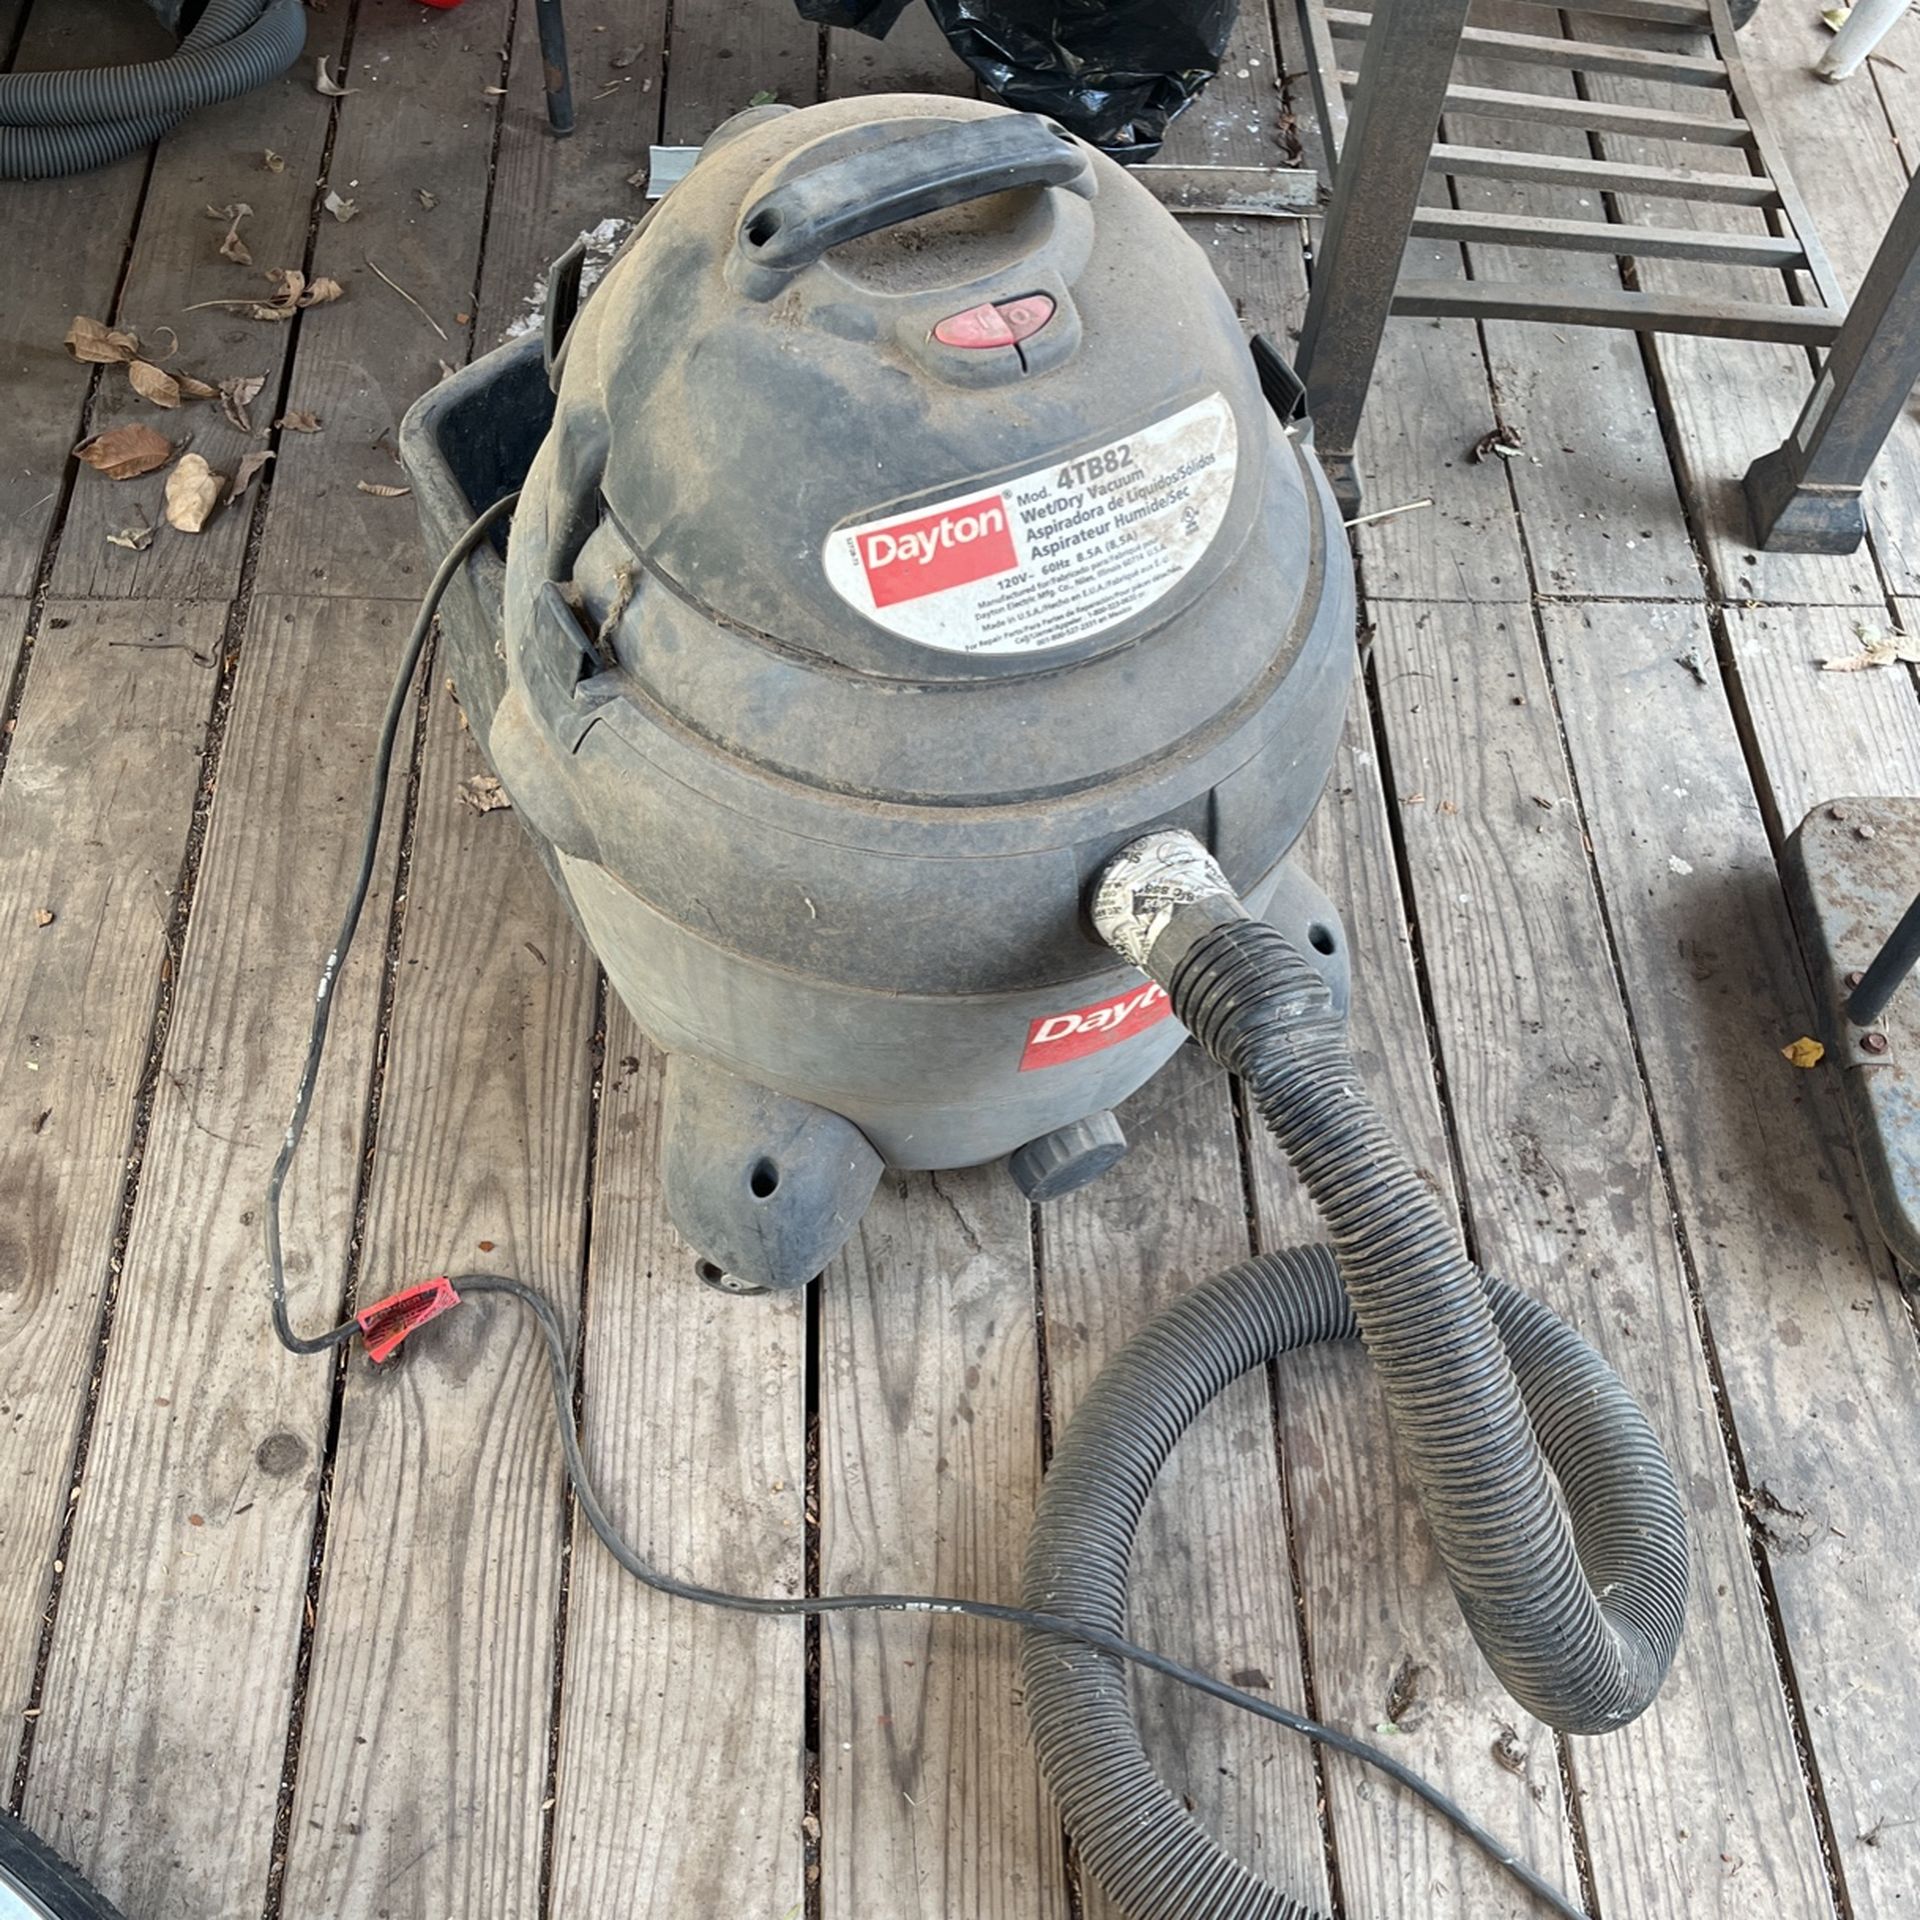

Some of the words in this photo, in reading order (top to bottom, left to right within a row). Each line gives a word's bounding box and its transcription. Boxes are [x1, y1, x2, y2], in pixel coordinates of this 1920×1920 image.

[1017, 486, 1052, 507] Mod.
[1057, 444, 1133, 489] 4TB82
[1020, 493, 1084, 524] Wet/Dry
[1087, 469, 1145, 499] Vacuum
[867, 508, 1003, 569] Dayton
[1026, 505, 1104, 543] Aspiradora
[1108, 496, 1124, 511] de
[1031, 522, 1111, 560] Aspirateur
[1113, 486, 1190, 528] Humide/Sec
[1041, 559, 1071, 575] 60Hz
[1076, 546, 1103, 562] 8.5A
[975, 606, 1005, 621] Dayton
[1006, 596, 1036, 611] Electric
[977, 585, 1036, 609] Manufactured
[1037, 566, 1090, 588] for/Fabricado
[965, 643, 978, 652] For
[1065, 610, 1075, 618] de
[982, 620, 1006, 632] Made
[1007, 616, 1017, 624] in
[1071, 594, 1081, 602] en
[1031, 984, 1168, 1044] Dayt
